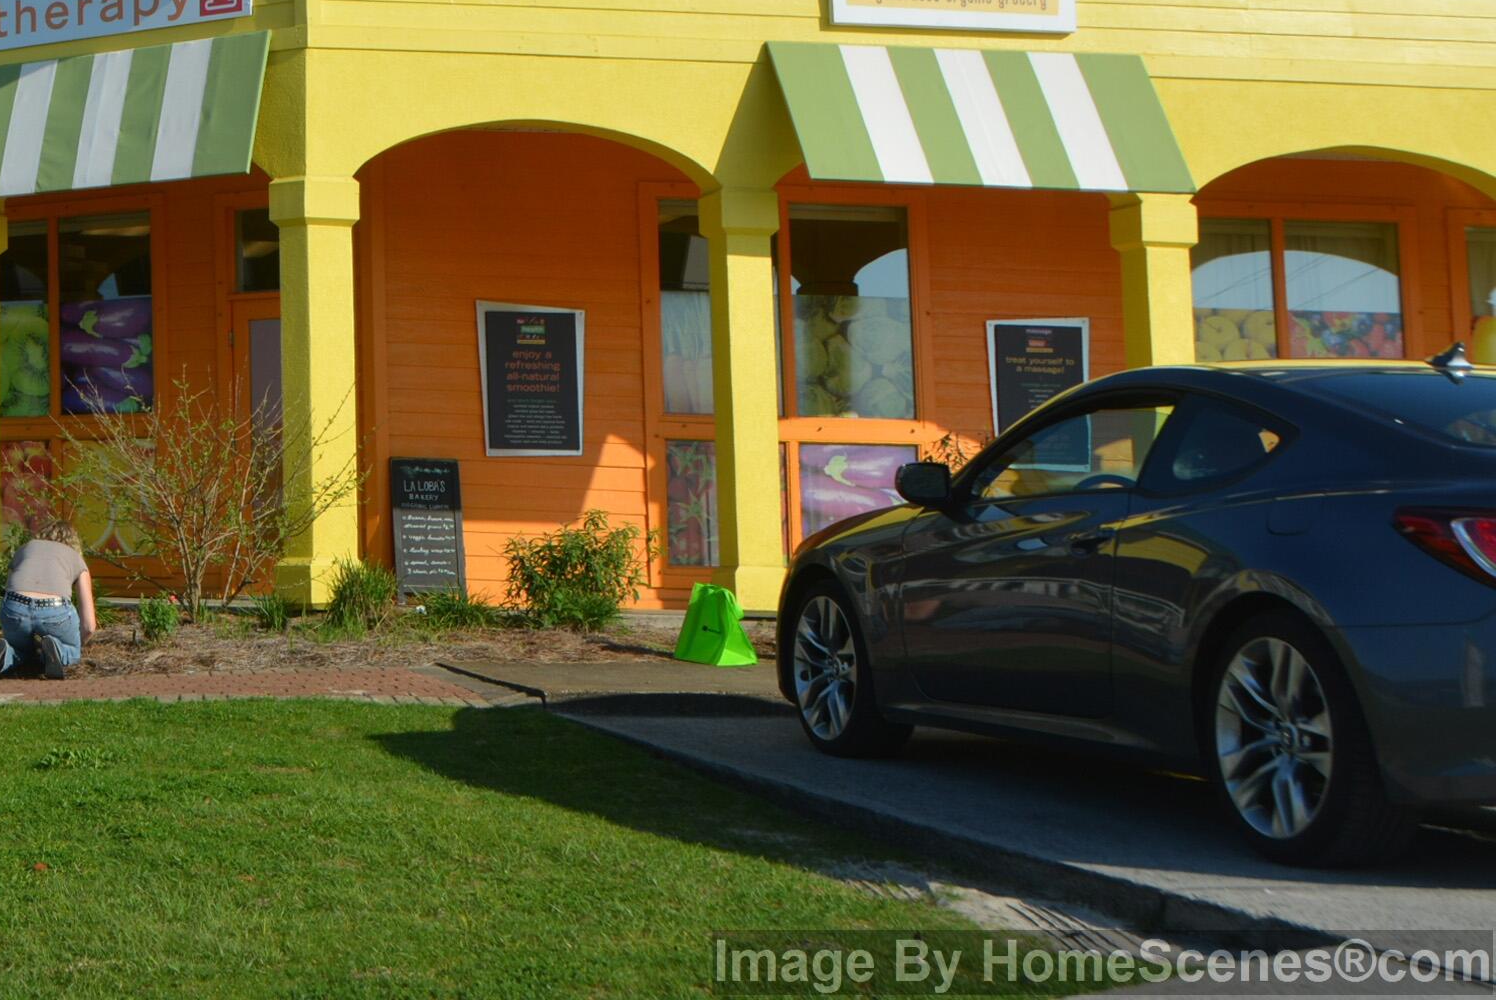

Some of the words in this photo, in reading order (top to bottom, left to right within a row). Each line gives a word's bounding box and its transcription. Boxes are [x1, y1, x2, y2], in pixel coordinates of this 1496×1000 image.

[512, 350, 541, 360] enjoy
[505, 361, 561, 372] refreshing
[506, 382, 560, 393] smoothie!
